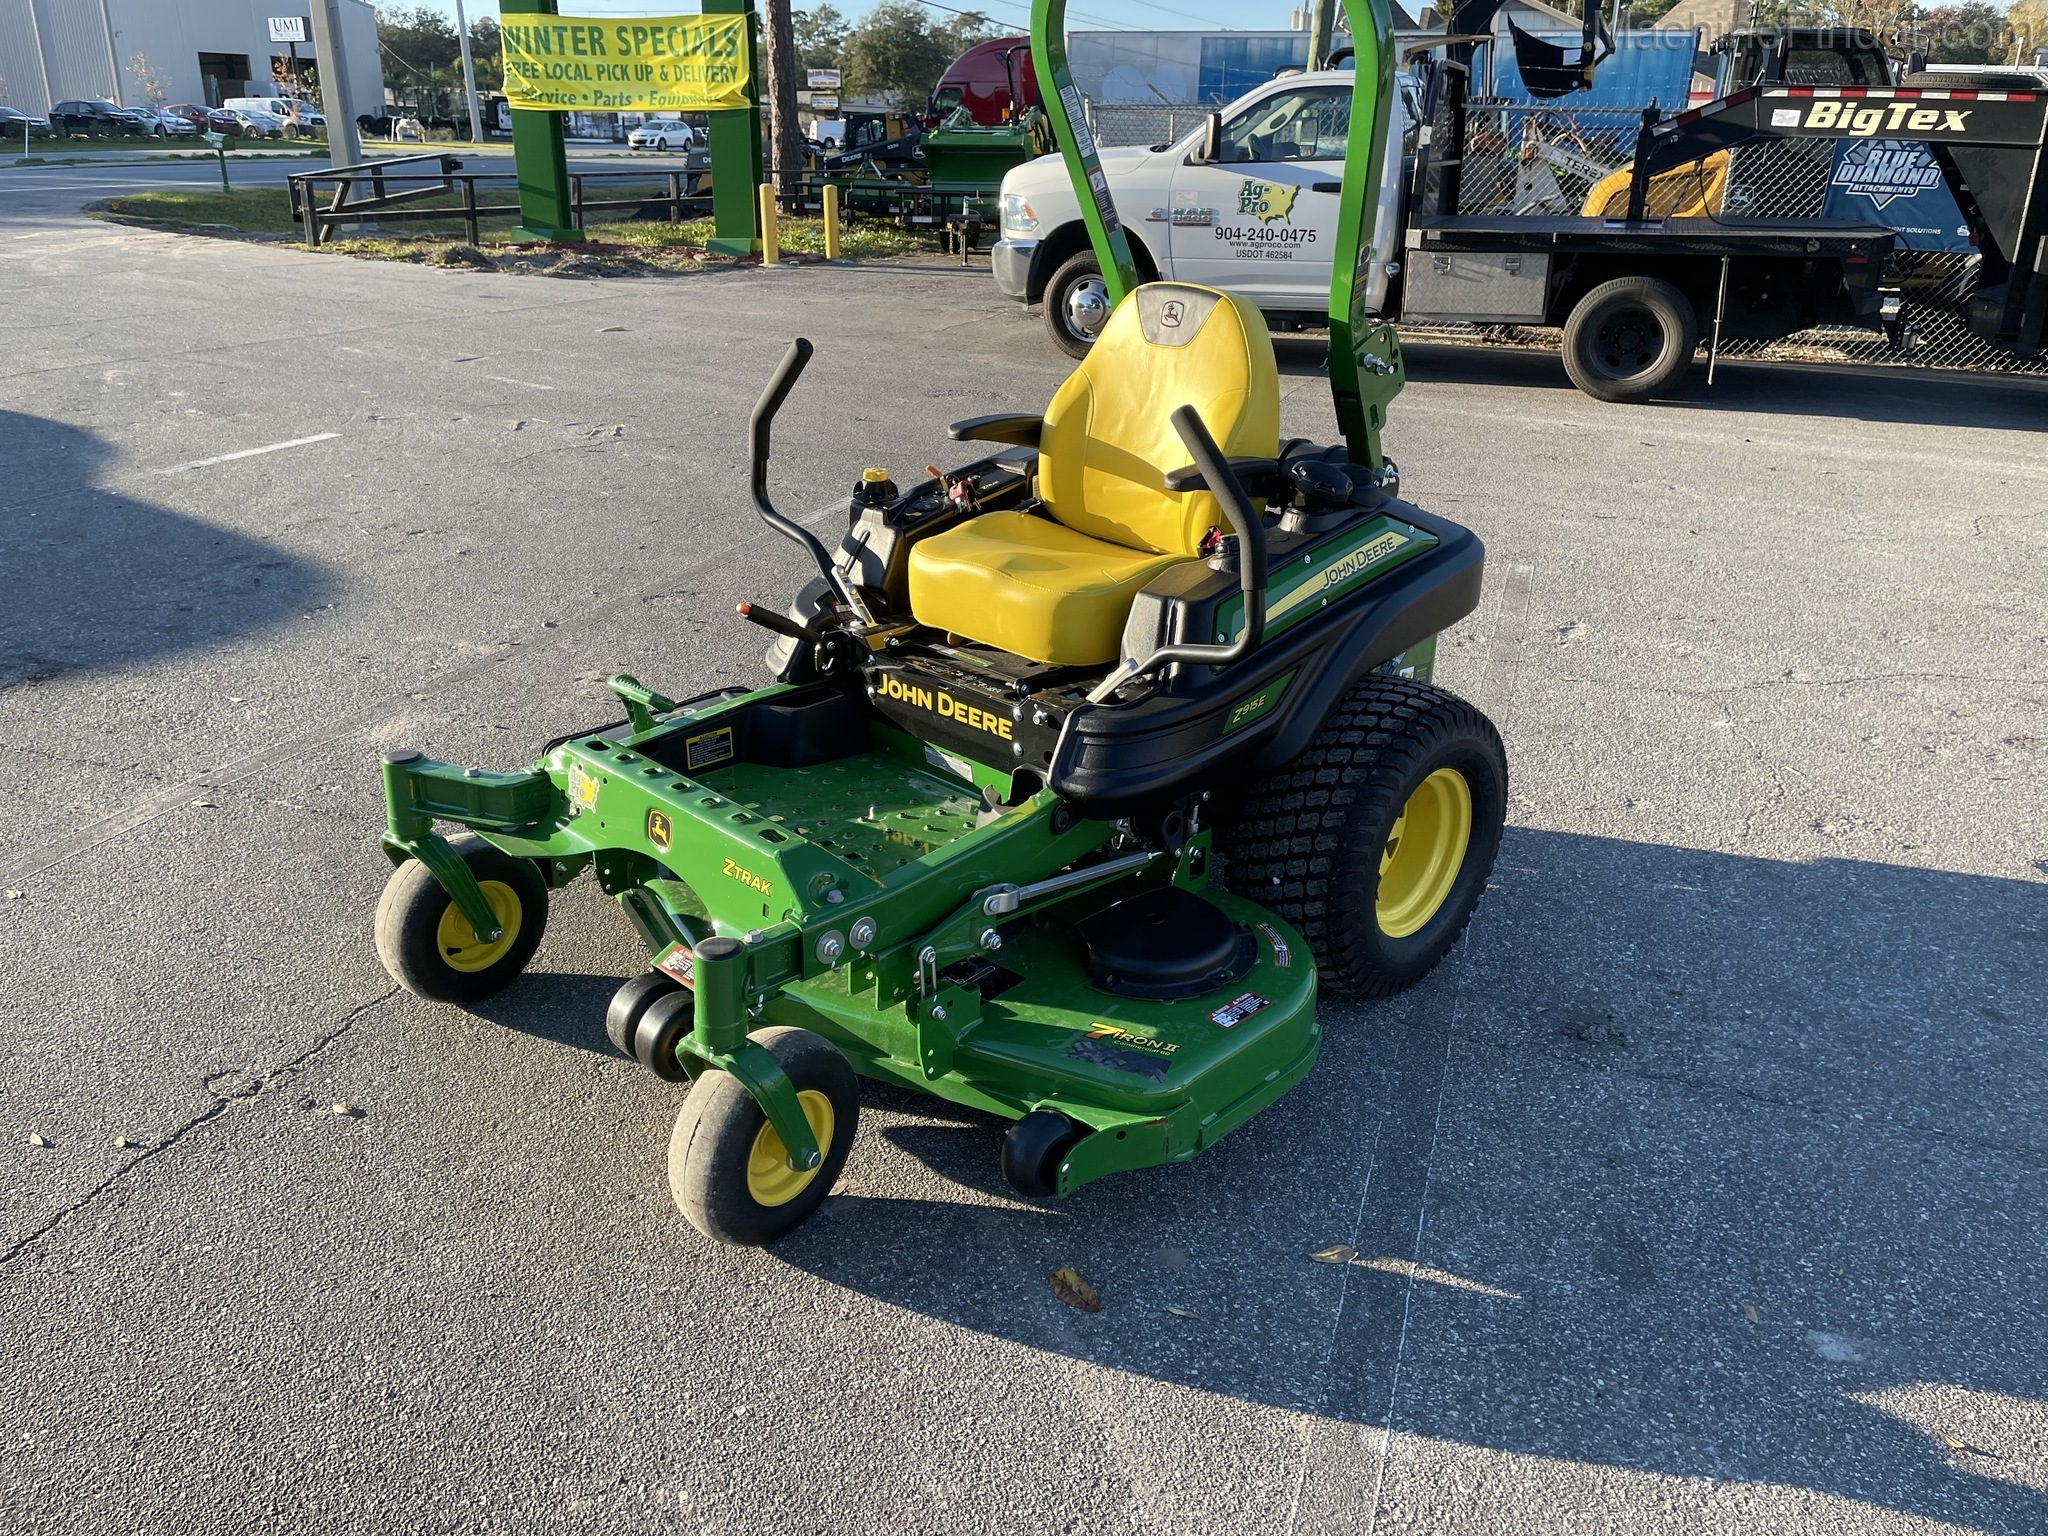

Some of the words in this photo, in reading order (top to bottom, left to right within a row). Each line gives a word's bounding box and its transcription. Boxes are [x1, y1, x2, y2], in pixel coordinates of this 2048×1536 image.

[272, 18, 299, 32] UMI
[501, 26, 607, 56] WINTER
[616, 26, 739, 57] SPECIALS
[505, 62, 540, 79] FREE
[545, 63, 593, 80] LOCAL
[596, 64, 631, 81] PICK
[635, 64, 653, 81] UP
[660, 65, 669, 81] &
[674, 64, 738, 83] DELIVERY
[594, 90, 632, 106] Parts
[650, 91, 720, 107] Equipme
[1803, 101, 1973, 136] BigTex
[1866, 150, 1920, 168] BLUE
[1837, 164, 1940, 187] DIAMOND
[1239, 179, 1271, 200] Ag-
[1852, 184, 1916, 194] ATTACHMENTS
[1238, 197, 1269, 215] Pro
[1215, 227, 1317, 243] 904-240-0475
[1229, 241, 1301, 249] www.agproco.com
[1236, 250, 1264, 258] USDOT
[1266, 250, 1293, 259] 462584
[1323, 558, 1356, 588] JOHN
[1356, 537, 1396, 568] DEERE
[877, 673, 933, 711] JOHN
[937, 691, 1013, 741] DEERE
[1232, 694, 1267, 724] Z915E
[722, 857, 774, 897] ZTRAK
[1113, 1040, 1159, 1054] Commercial
